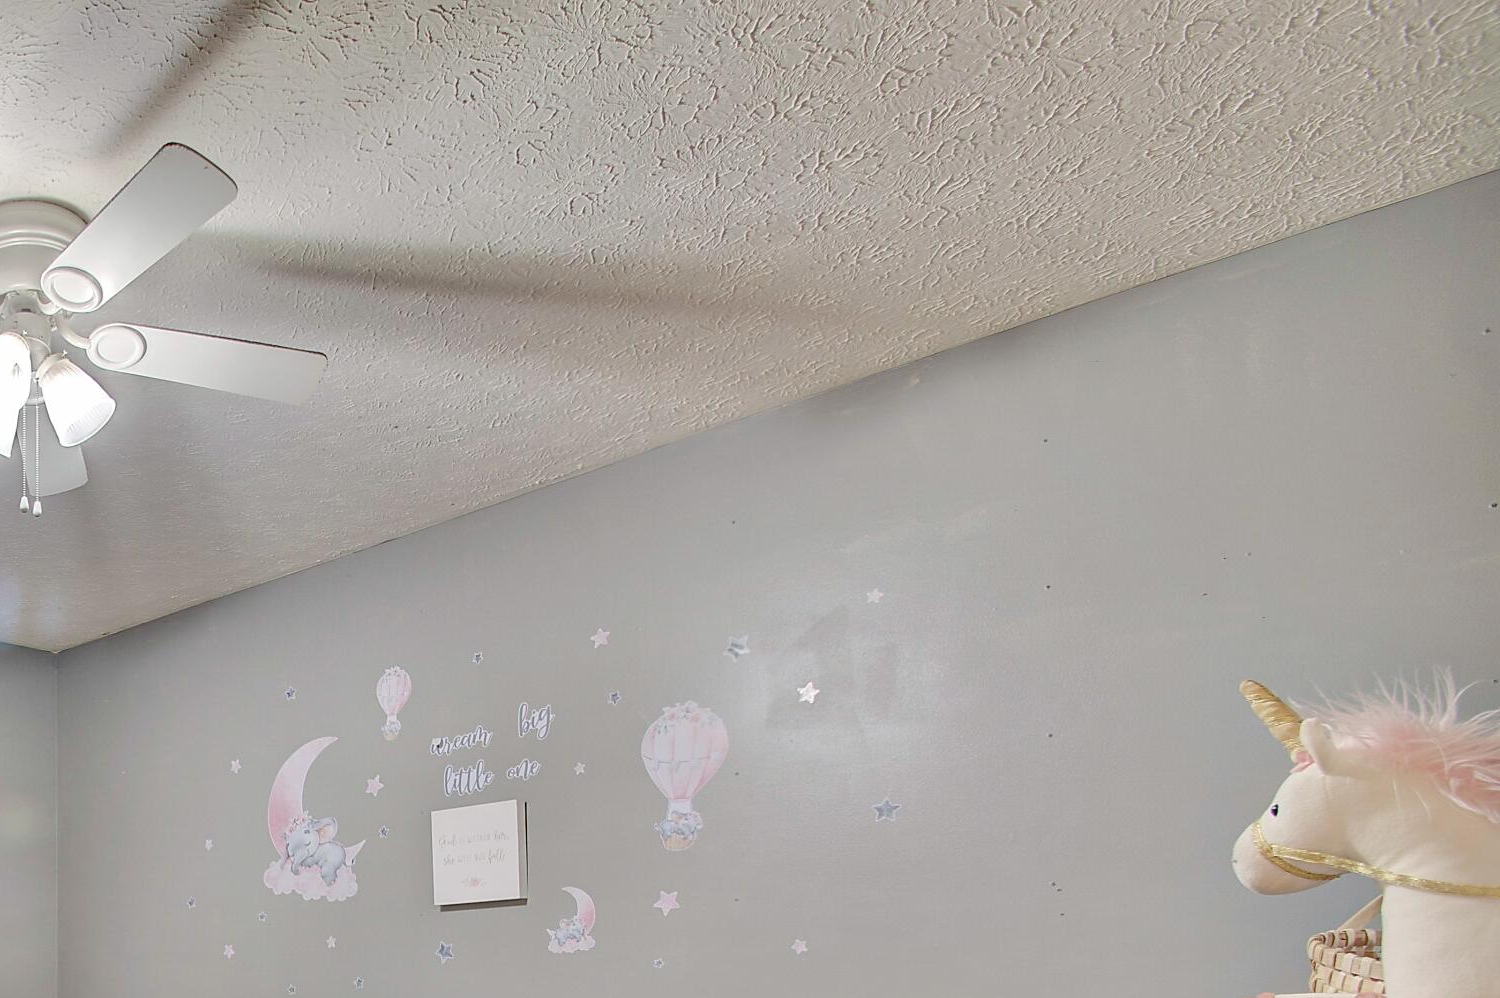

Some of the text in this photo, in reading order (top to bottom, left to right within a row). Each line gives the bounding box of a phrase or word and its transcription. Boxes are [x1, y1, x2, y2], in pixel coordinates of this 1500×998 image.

[517, 703, 555, 739] big
[444, 760, 540, 795] little one
